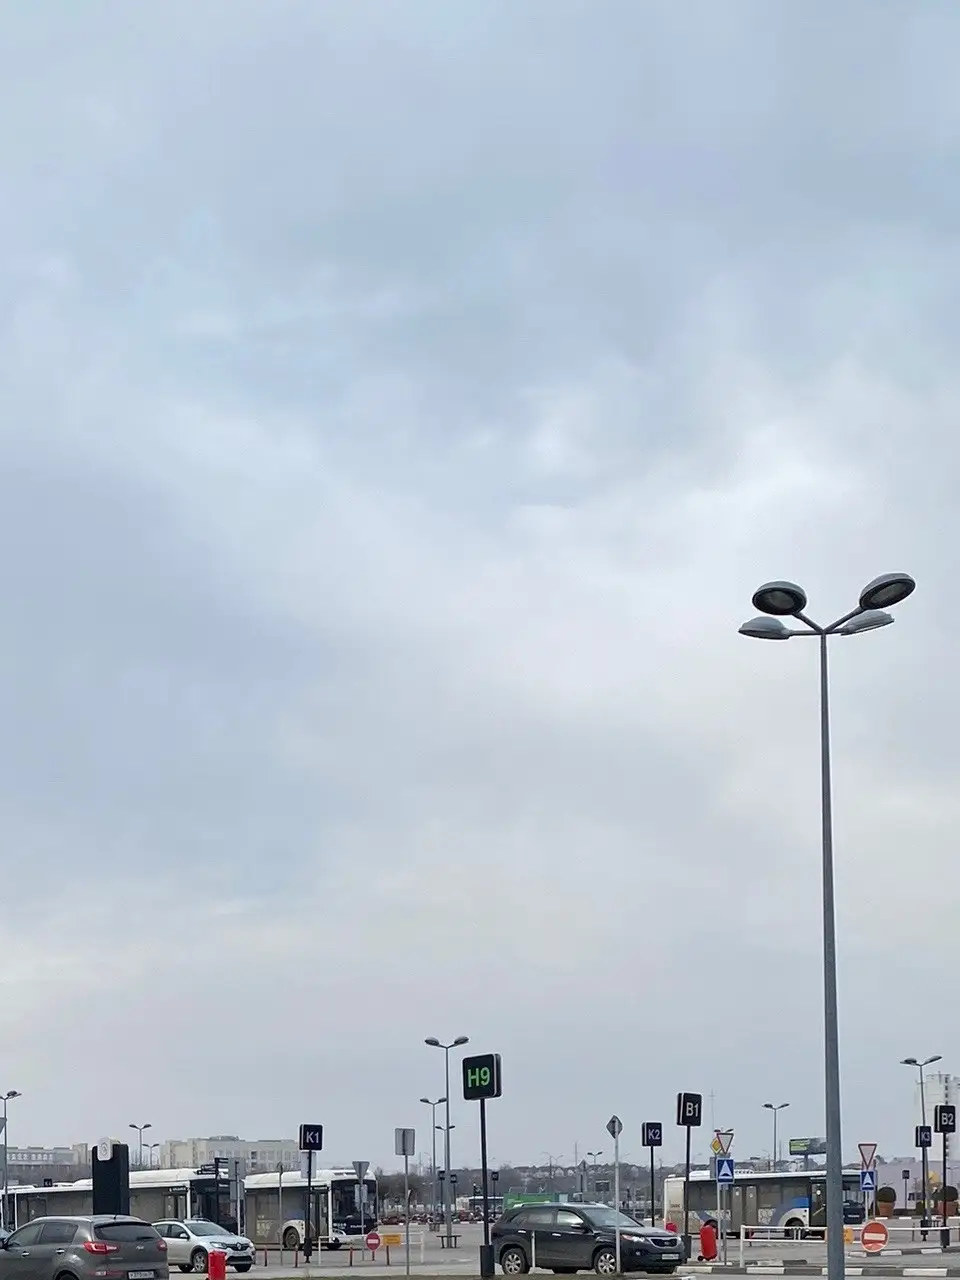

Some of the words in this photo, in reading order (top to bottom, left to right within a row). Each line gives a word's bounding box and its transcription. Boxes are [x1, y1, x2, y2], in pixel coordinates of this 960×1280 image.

[467, 1066, 490, 1088] H9
[686, 1101, 699, 1117] B1
[306, 1131, 319, 1144] K1
